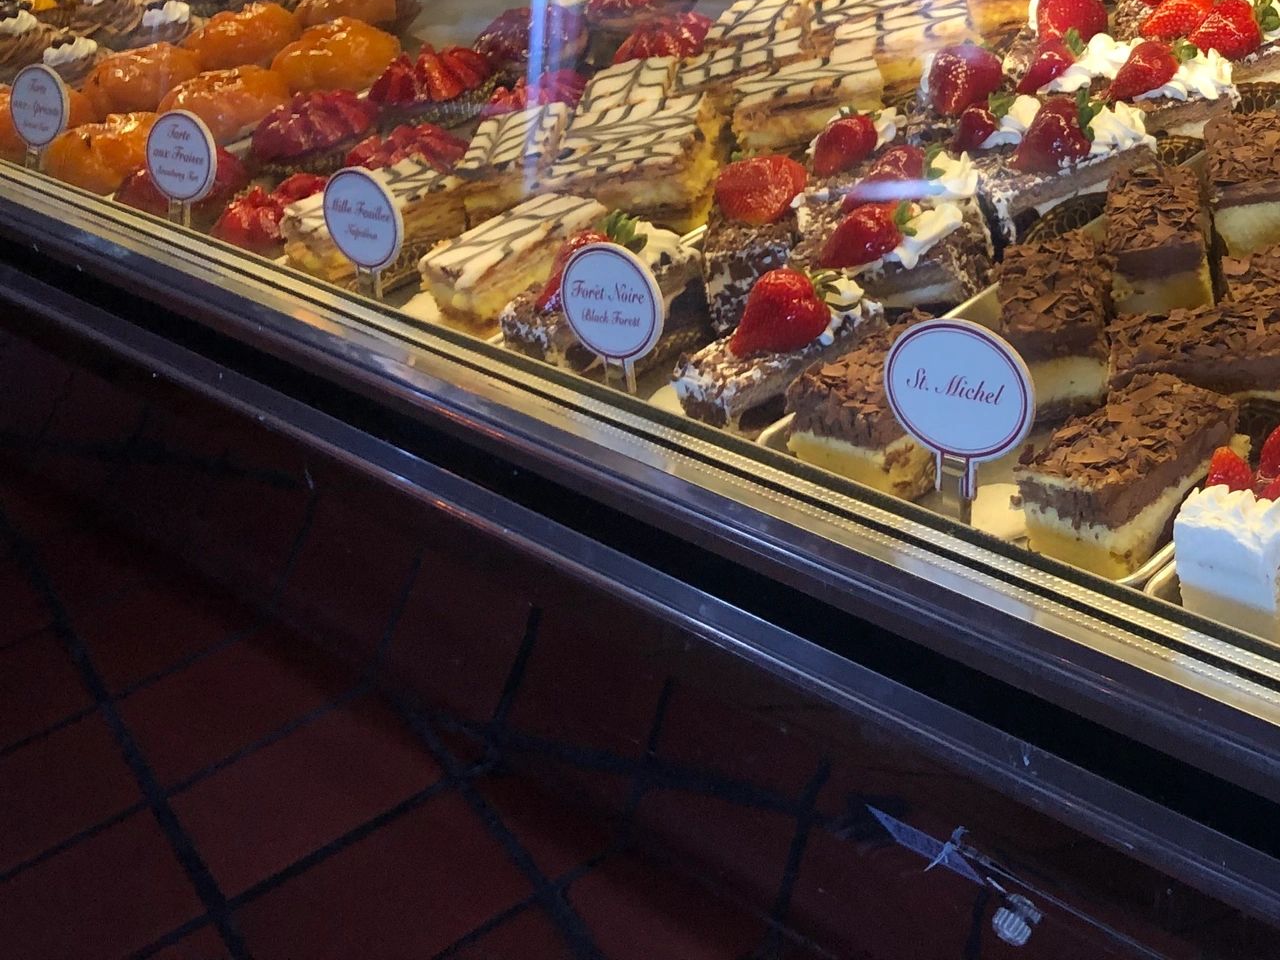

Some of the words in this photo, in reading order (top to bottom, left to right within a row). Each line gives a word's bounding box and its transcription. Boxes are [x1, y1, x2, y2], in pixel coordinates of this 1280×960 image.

[607, 282, 645, 305] Noire
[906, 367, 930, 392] St.
[935, 374, 1005, 406] Michel
